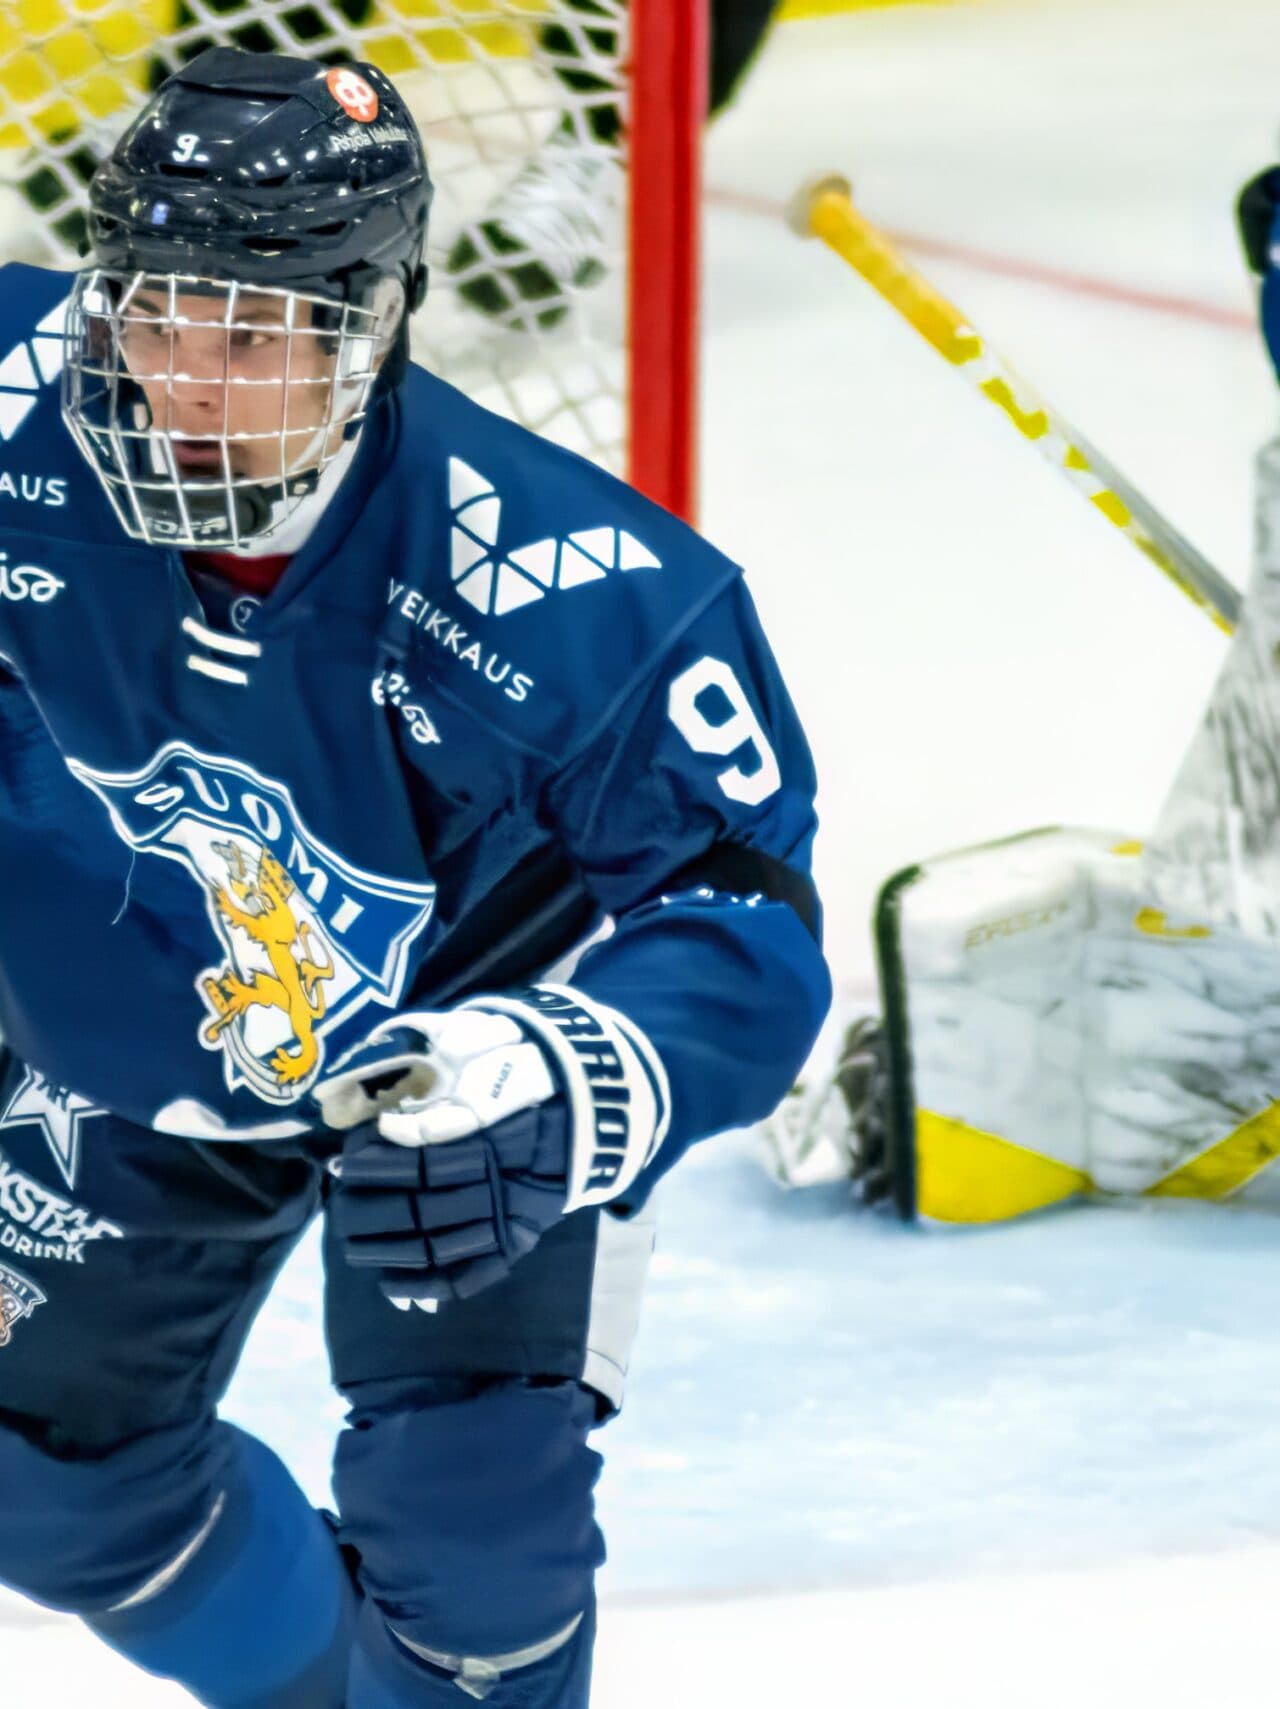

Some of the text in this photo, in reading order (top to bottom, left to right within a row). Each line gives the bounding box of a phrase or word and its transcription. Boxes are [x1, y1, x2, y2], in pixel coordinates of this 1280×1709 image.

[667, 655, 782, 806] 9
[134, 766, 365, 935] SUOMI
[0, 1224, 85, 1264] DRINK
